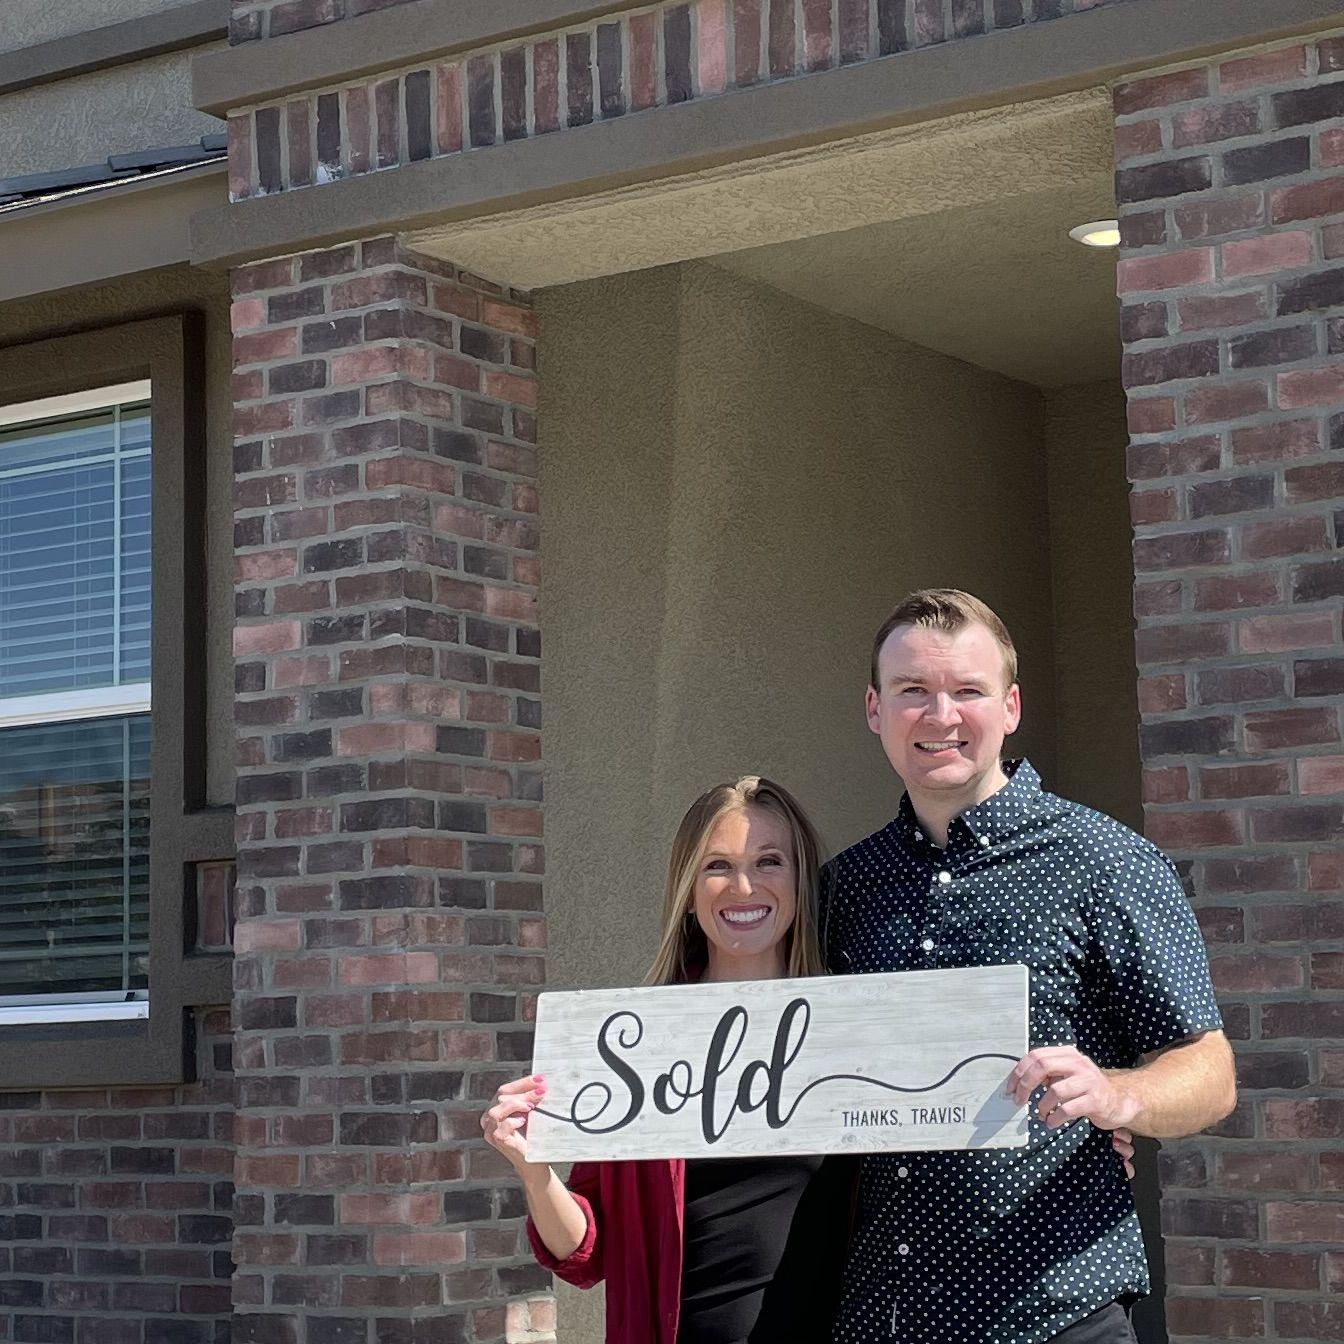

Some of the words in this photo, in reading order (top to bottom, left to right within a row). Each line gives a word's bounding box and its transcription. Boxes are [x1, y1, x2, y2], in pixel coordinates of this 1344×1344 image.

[564, 997, 818, 1144] Sold
[842, 1109, 903, 1127] THANKS,
[910, 1107, 966, 1125] TRAVIS!
